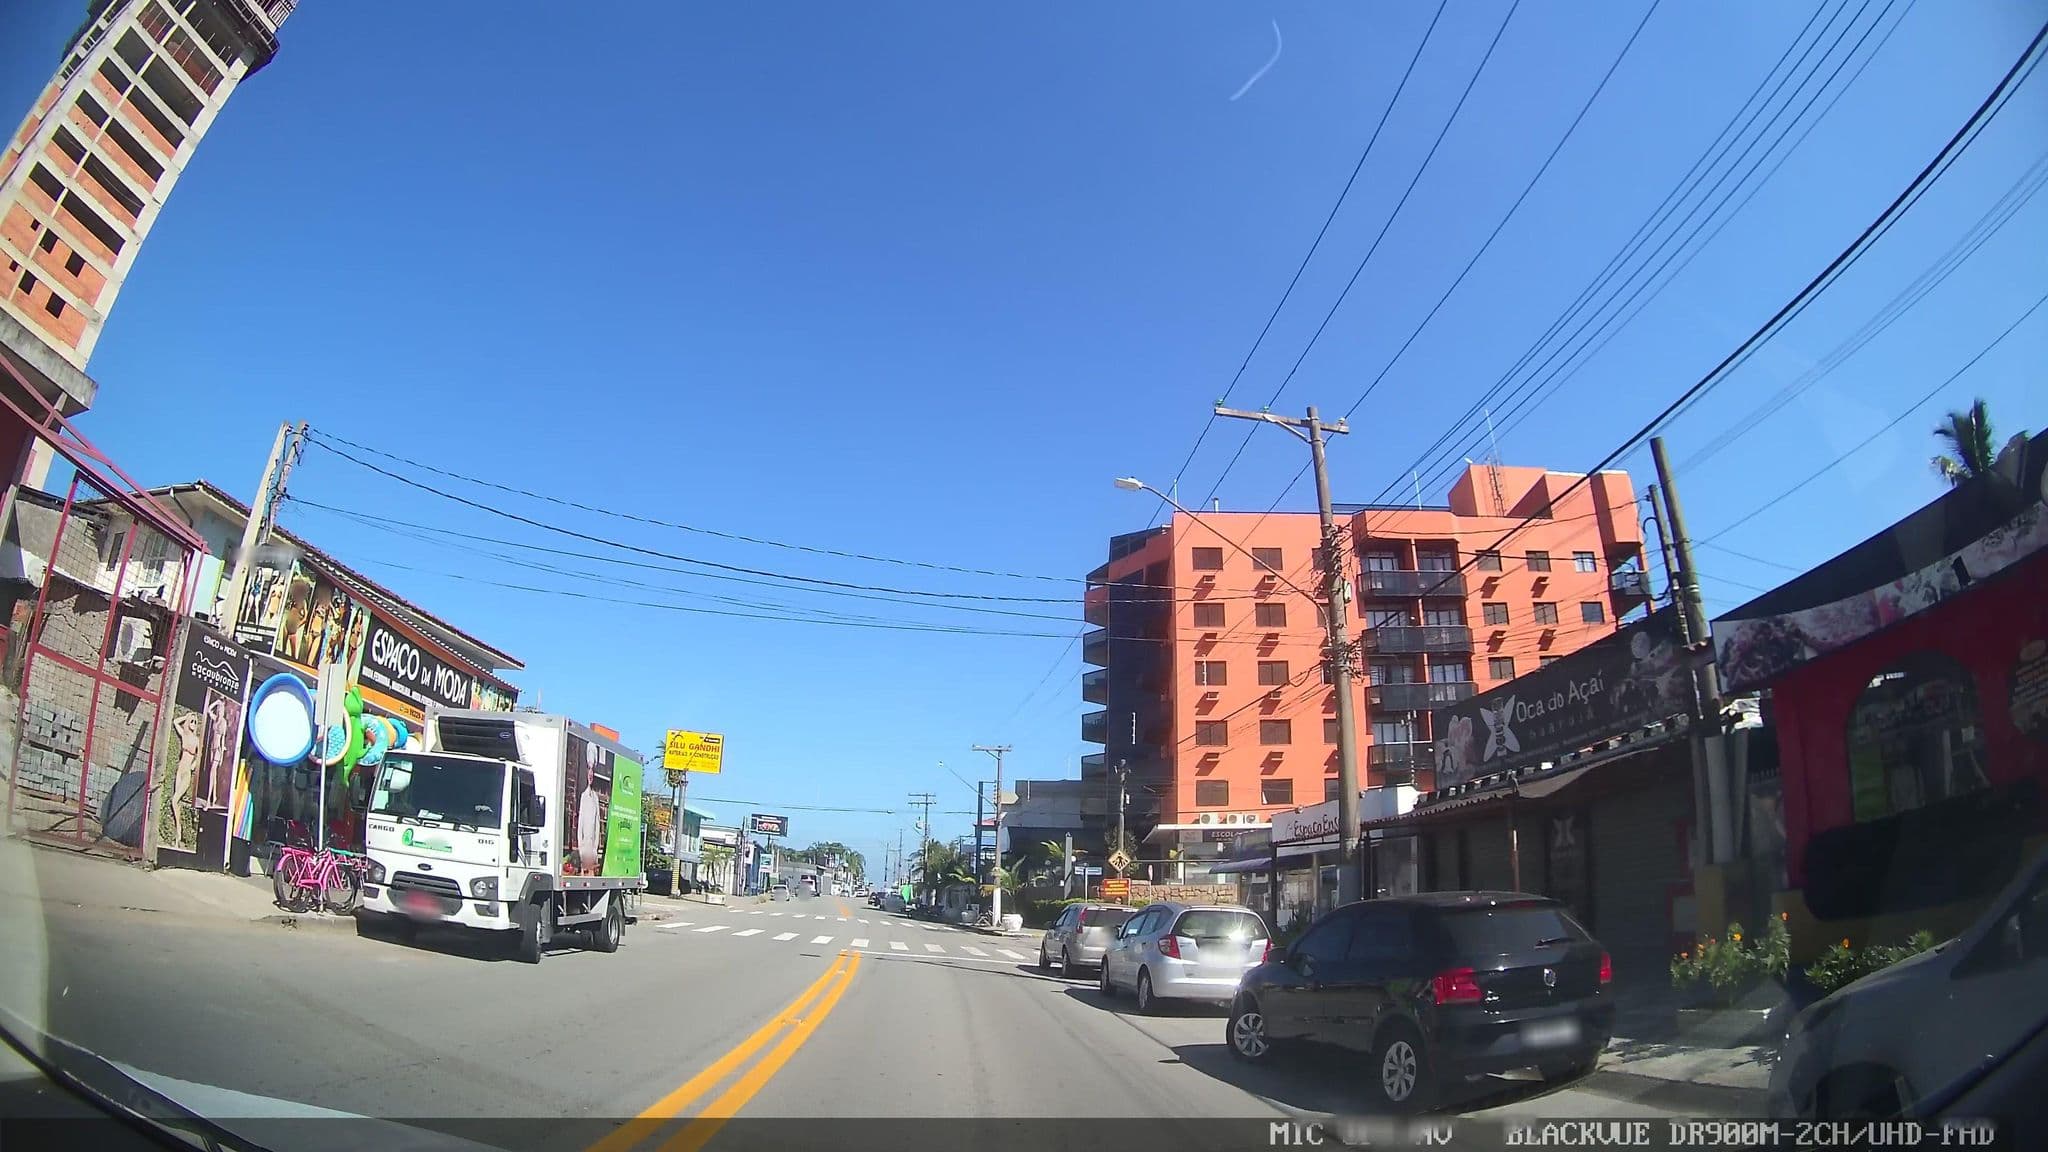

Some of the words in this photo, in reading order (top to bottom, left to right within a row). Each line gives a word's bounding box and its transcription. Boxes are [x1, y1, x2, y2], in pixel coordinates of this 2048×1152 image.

[191, 662, 239, 690] cacaubronze
[372, 628, 420, 680] ESPAÇO
[421, 666, 432, 687] DA
[433, 664, 469, 706] MODA
[1515, 700, 1545, 723] Oca
[1547, 693, 1565, 711] do
[1568, 668, 1606, 706] Açaí
[688, 743, 720, 753] GANDHI
[368, 823, 395, 832] CARGO
